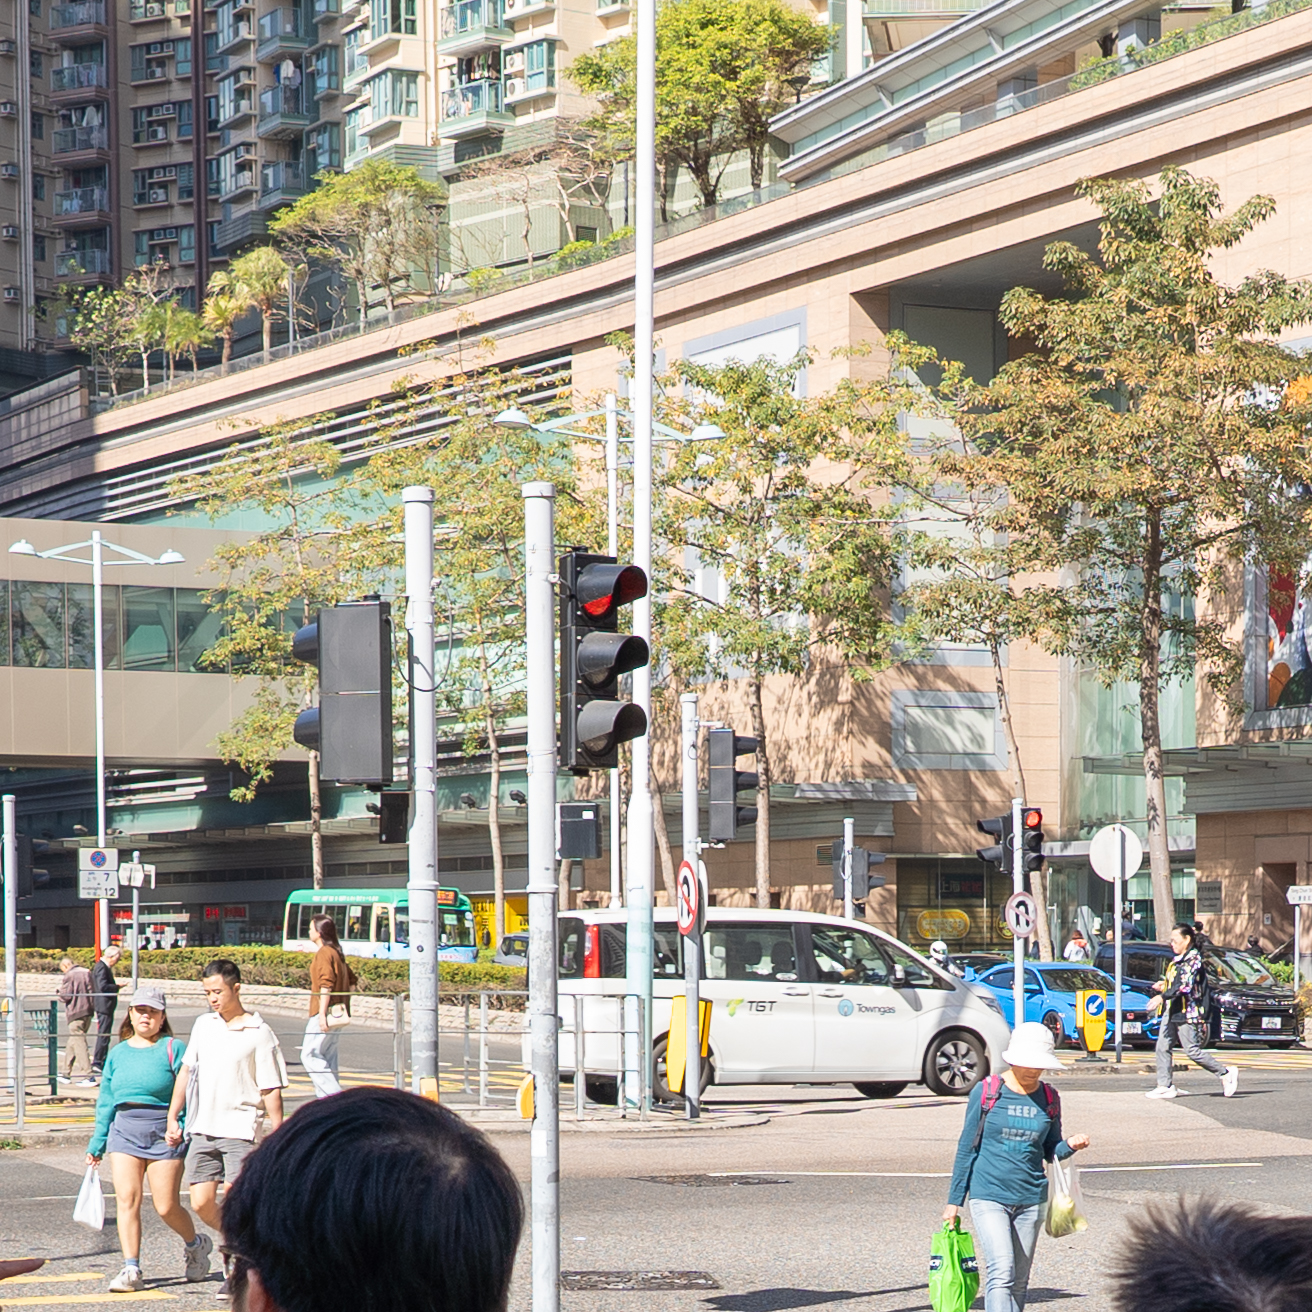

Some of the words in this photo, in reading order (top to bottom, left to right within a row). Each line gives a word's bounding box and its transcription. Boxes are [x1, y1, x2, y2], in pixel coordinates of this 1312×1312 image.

[104, 873, 110, 881] 7
[104, 888, 116, 896] 12
[747, 1000, 777, 1012] TGT
[856, 1003, 896, 1015] Towngas
[1007, 1105, 1037, 1118] KEEP
[1008, 1117, 1038, 1130] YOUR
